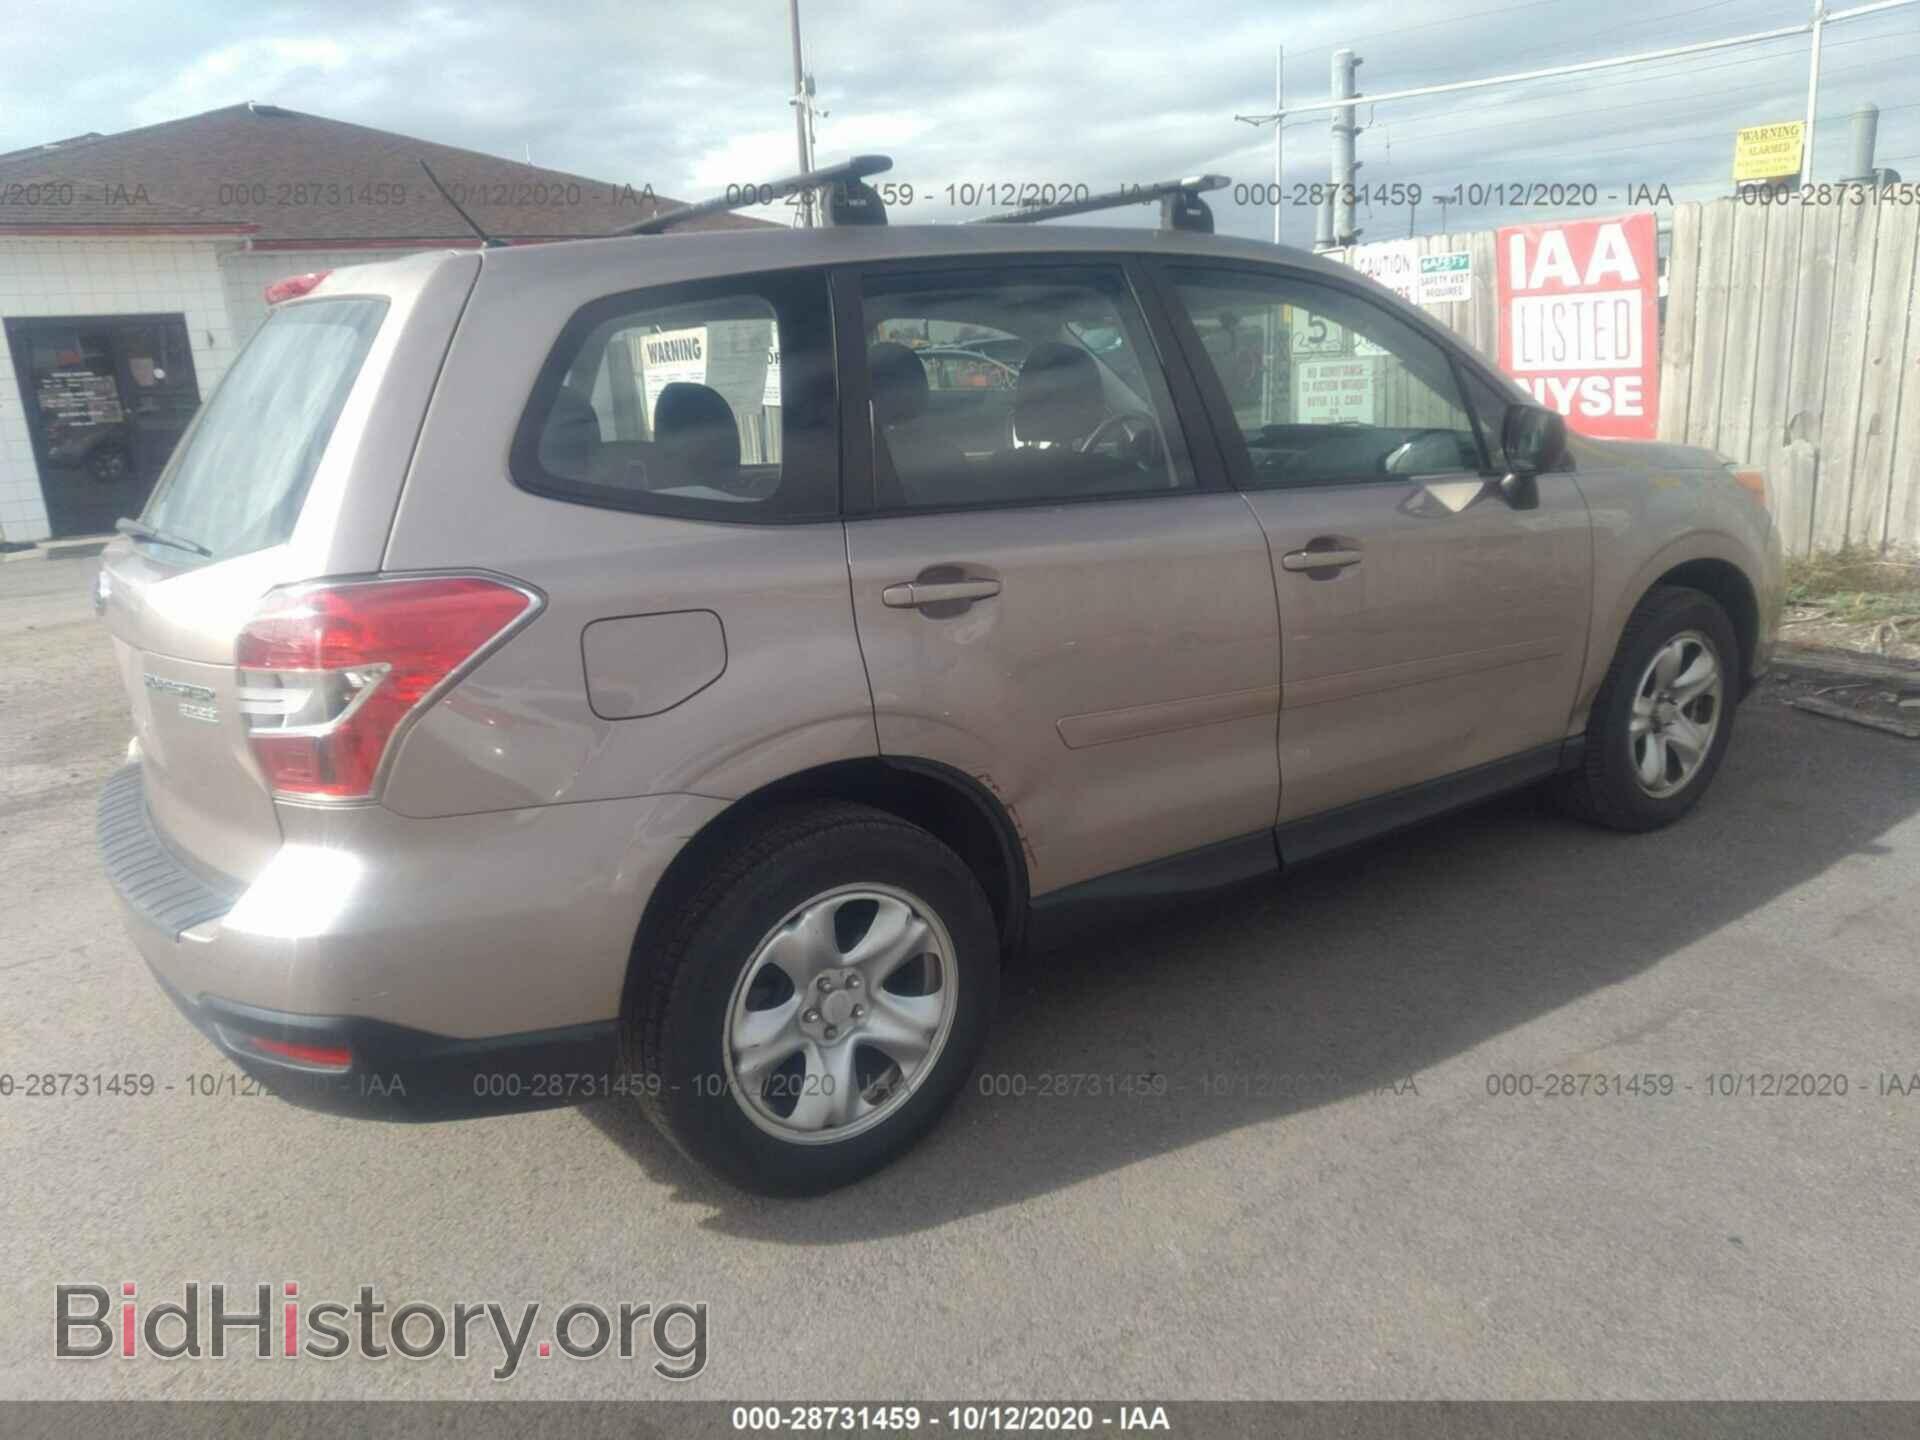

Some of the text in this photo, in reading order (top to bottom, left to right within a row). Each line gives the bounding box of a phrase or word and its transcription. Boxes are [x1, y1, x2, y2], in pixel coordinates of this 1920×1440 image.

[1742, 125, 1800, 141] WARNING
[1360, 254, 1411, 276] CAUTION
[1509, 223, 1641, 290] IAA
[1521, 299, 1631, 363] LISTED
[646, 336, 702, 365] WARNING
